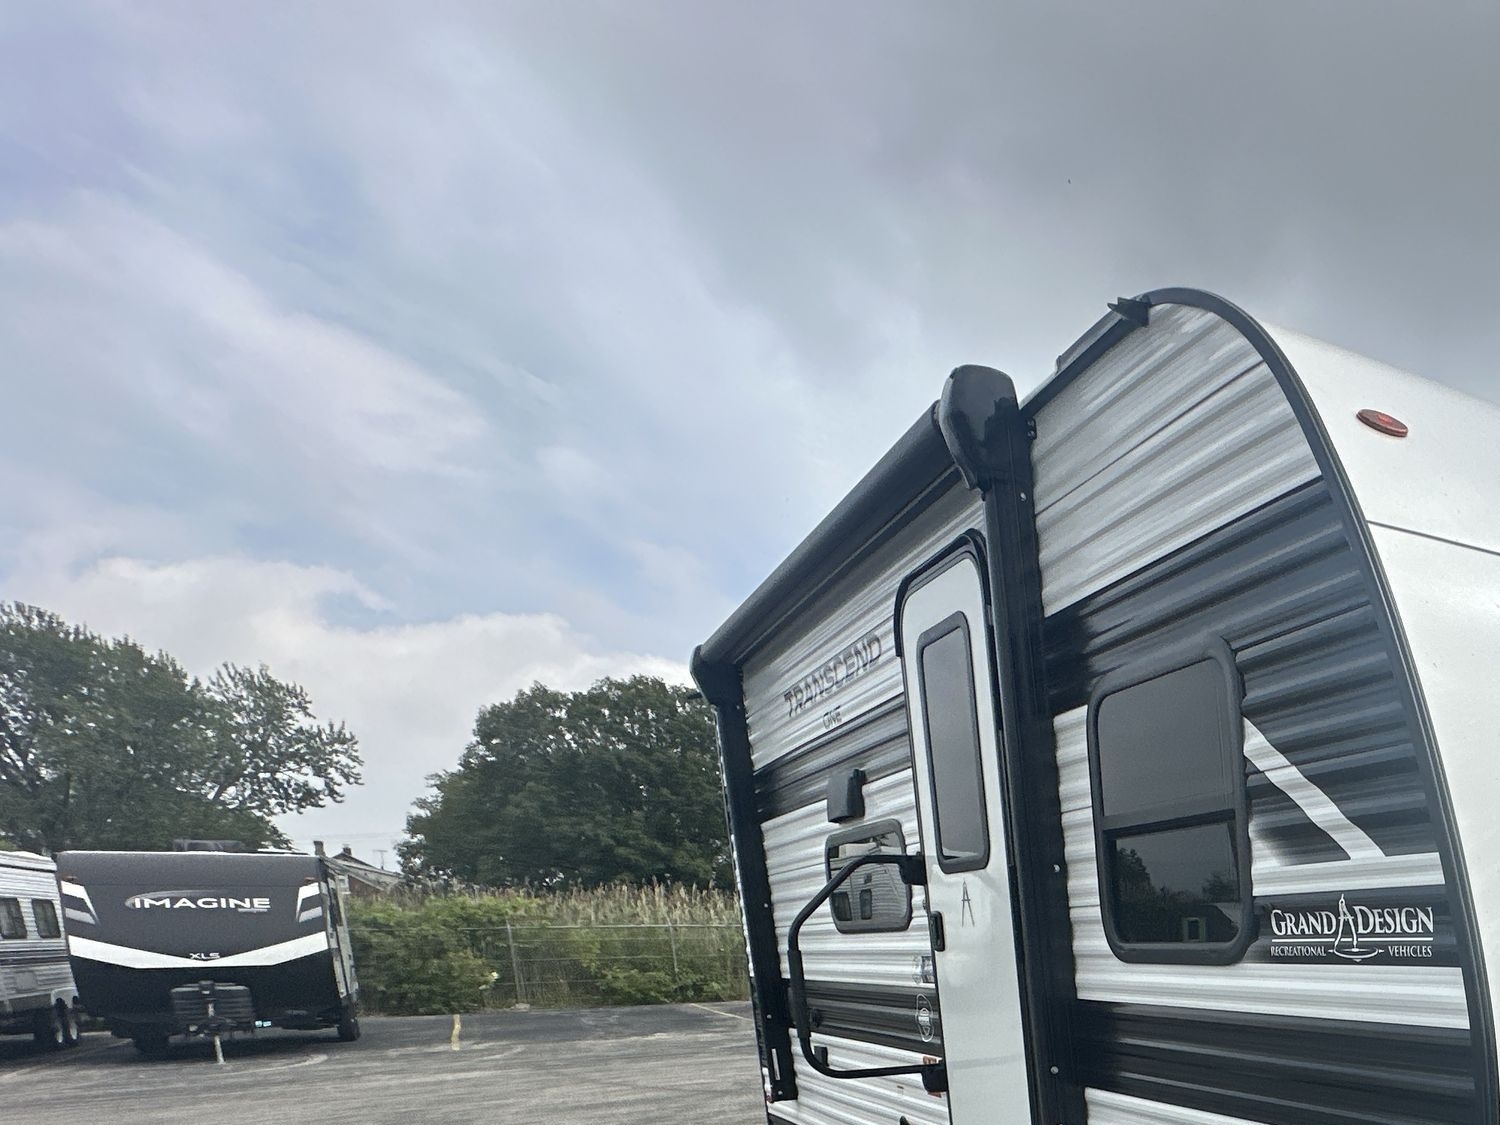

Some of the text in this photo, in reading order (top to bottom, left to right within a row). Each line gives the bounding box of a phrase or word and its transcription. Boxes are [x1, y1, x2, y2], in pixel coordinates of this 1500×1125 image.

[784, 634, 882, 718] TRANSCEND
[134, 897, 271, 909] IMAGINE
[1271, 905, 1434, 936] GRAND DESIGN
[189, 952, 221, 960] XLS
[1270, 945, 1432, 958] RECREATIONAL VEHICLES
